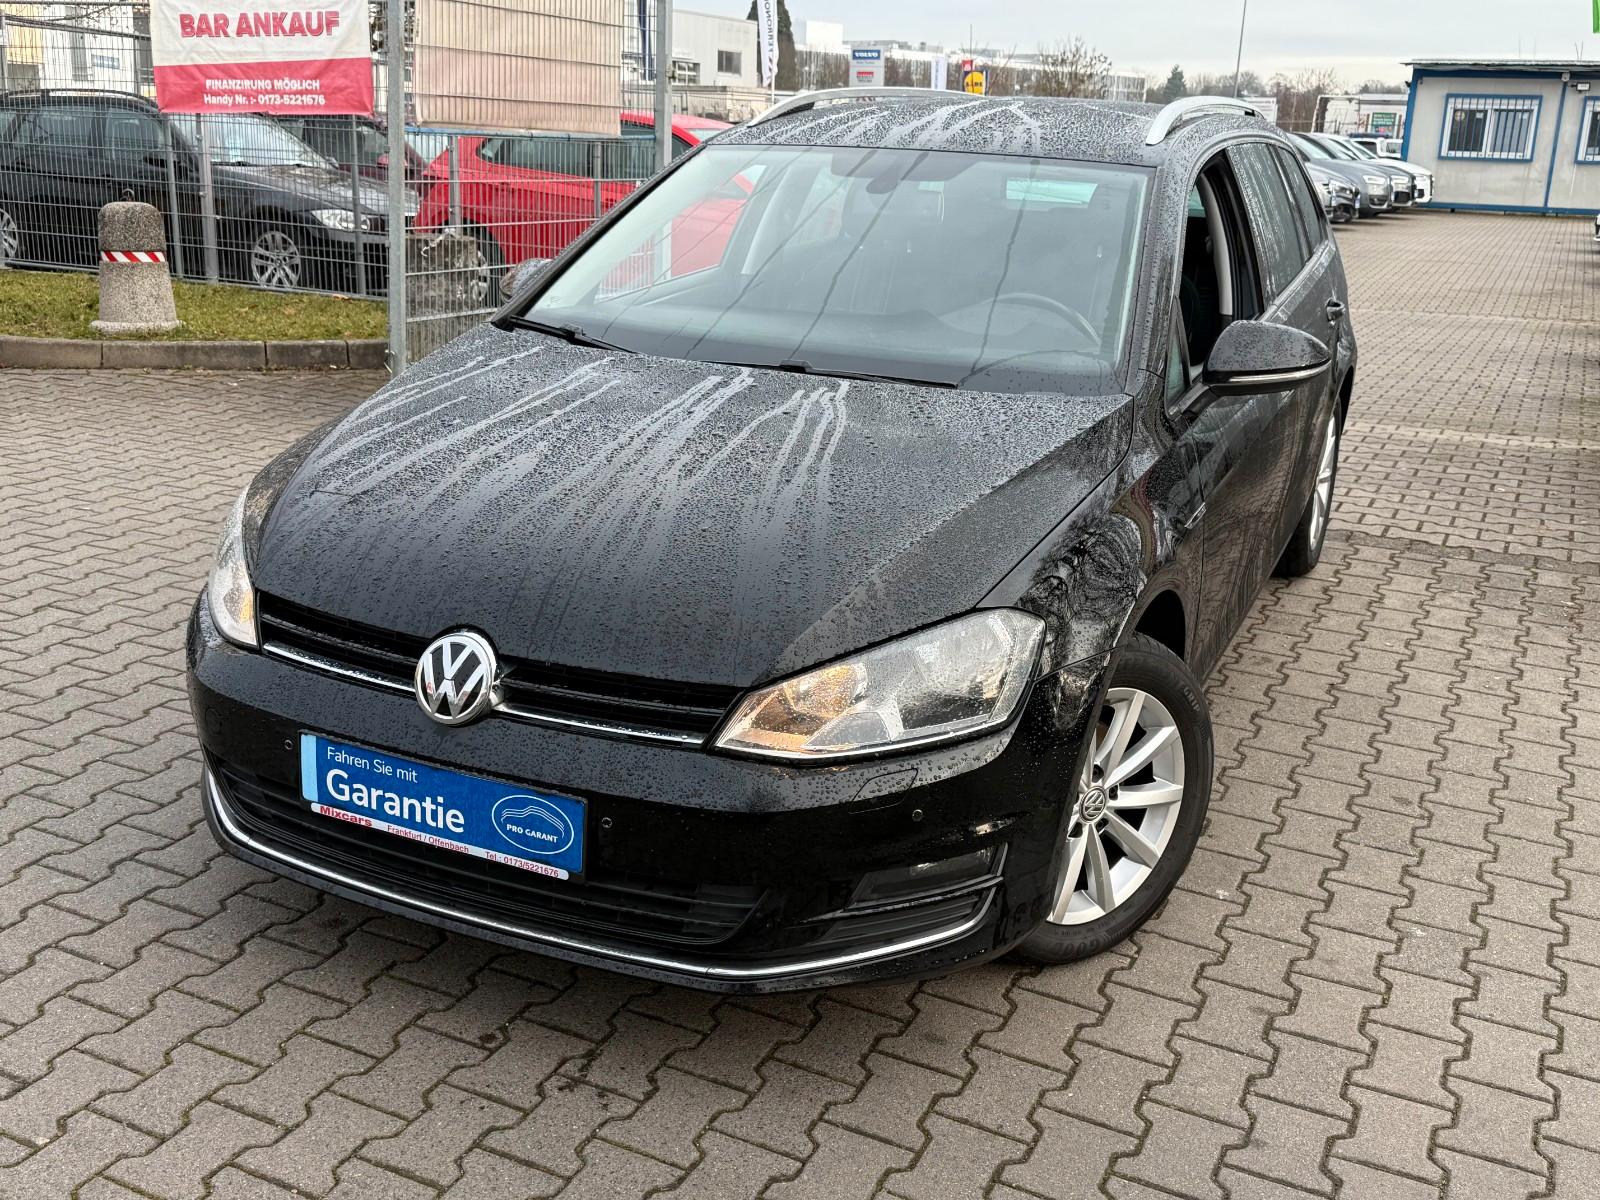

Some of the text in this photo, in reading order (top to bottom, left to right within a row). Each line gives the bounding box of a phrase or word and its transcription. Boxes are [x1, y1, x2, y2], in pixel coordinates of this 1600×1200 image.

[179, 10, 340, 38] BAR ANKAUF
[205, 77, 321, 90] FINANZIRUNG MÖGLICH
[203, 94, 234, 107] Handy
[235, 94, 249, 105] Nr.
[327, 746, 418, 784] Fahren Sie mit
[326, 768, 465, 833] Garantie
[319, 805, 373, 827] Mixcars
[387, 824, 424, 841] Frankfurt
[428, 836, 470, 853] Offenbach
[503, 856, 559, 878] 0173/5221676
[506, 823, 559, 844] PRO GARANT
